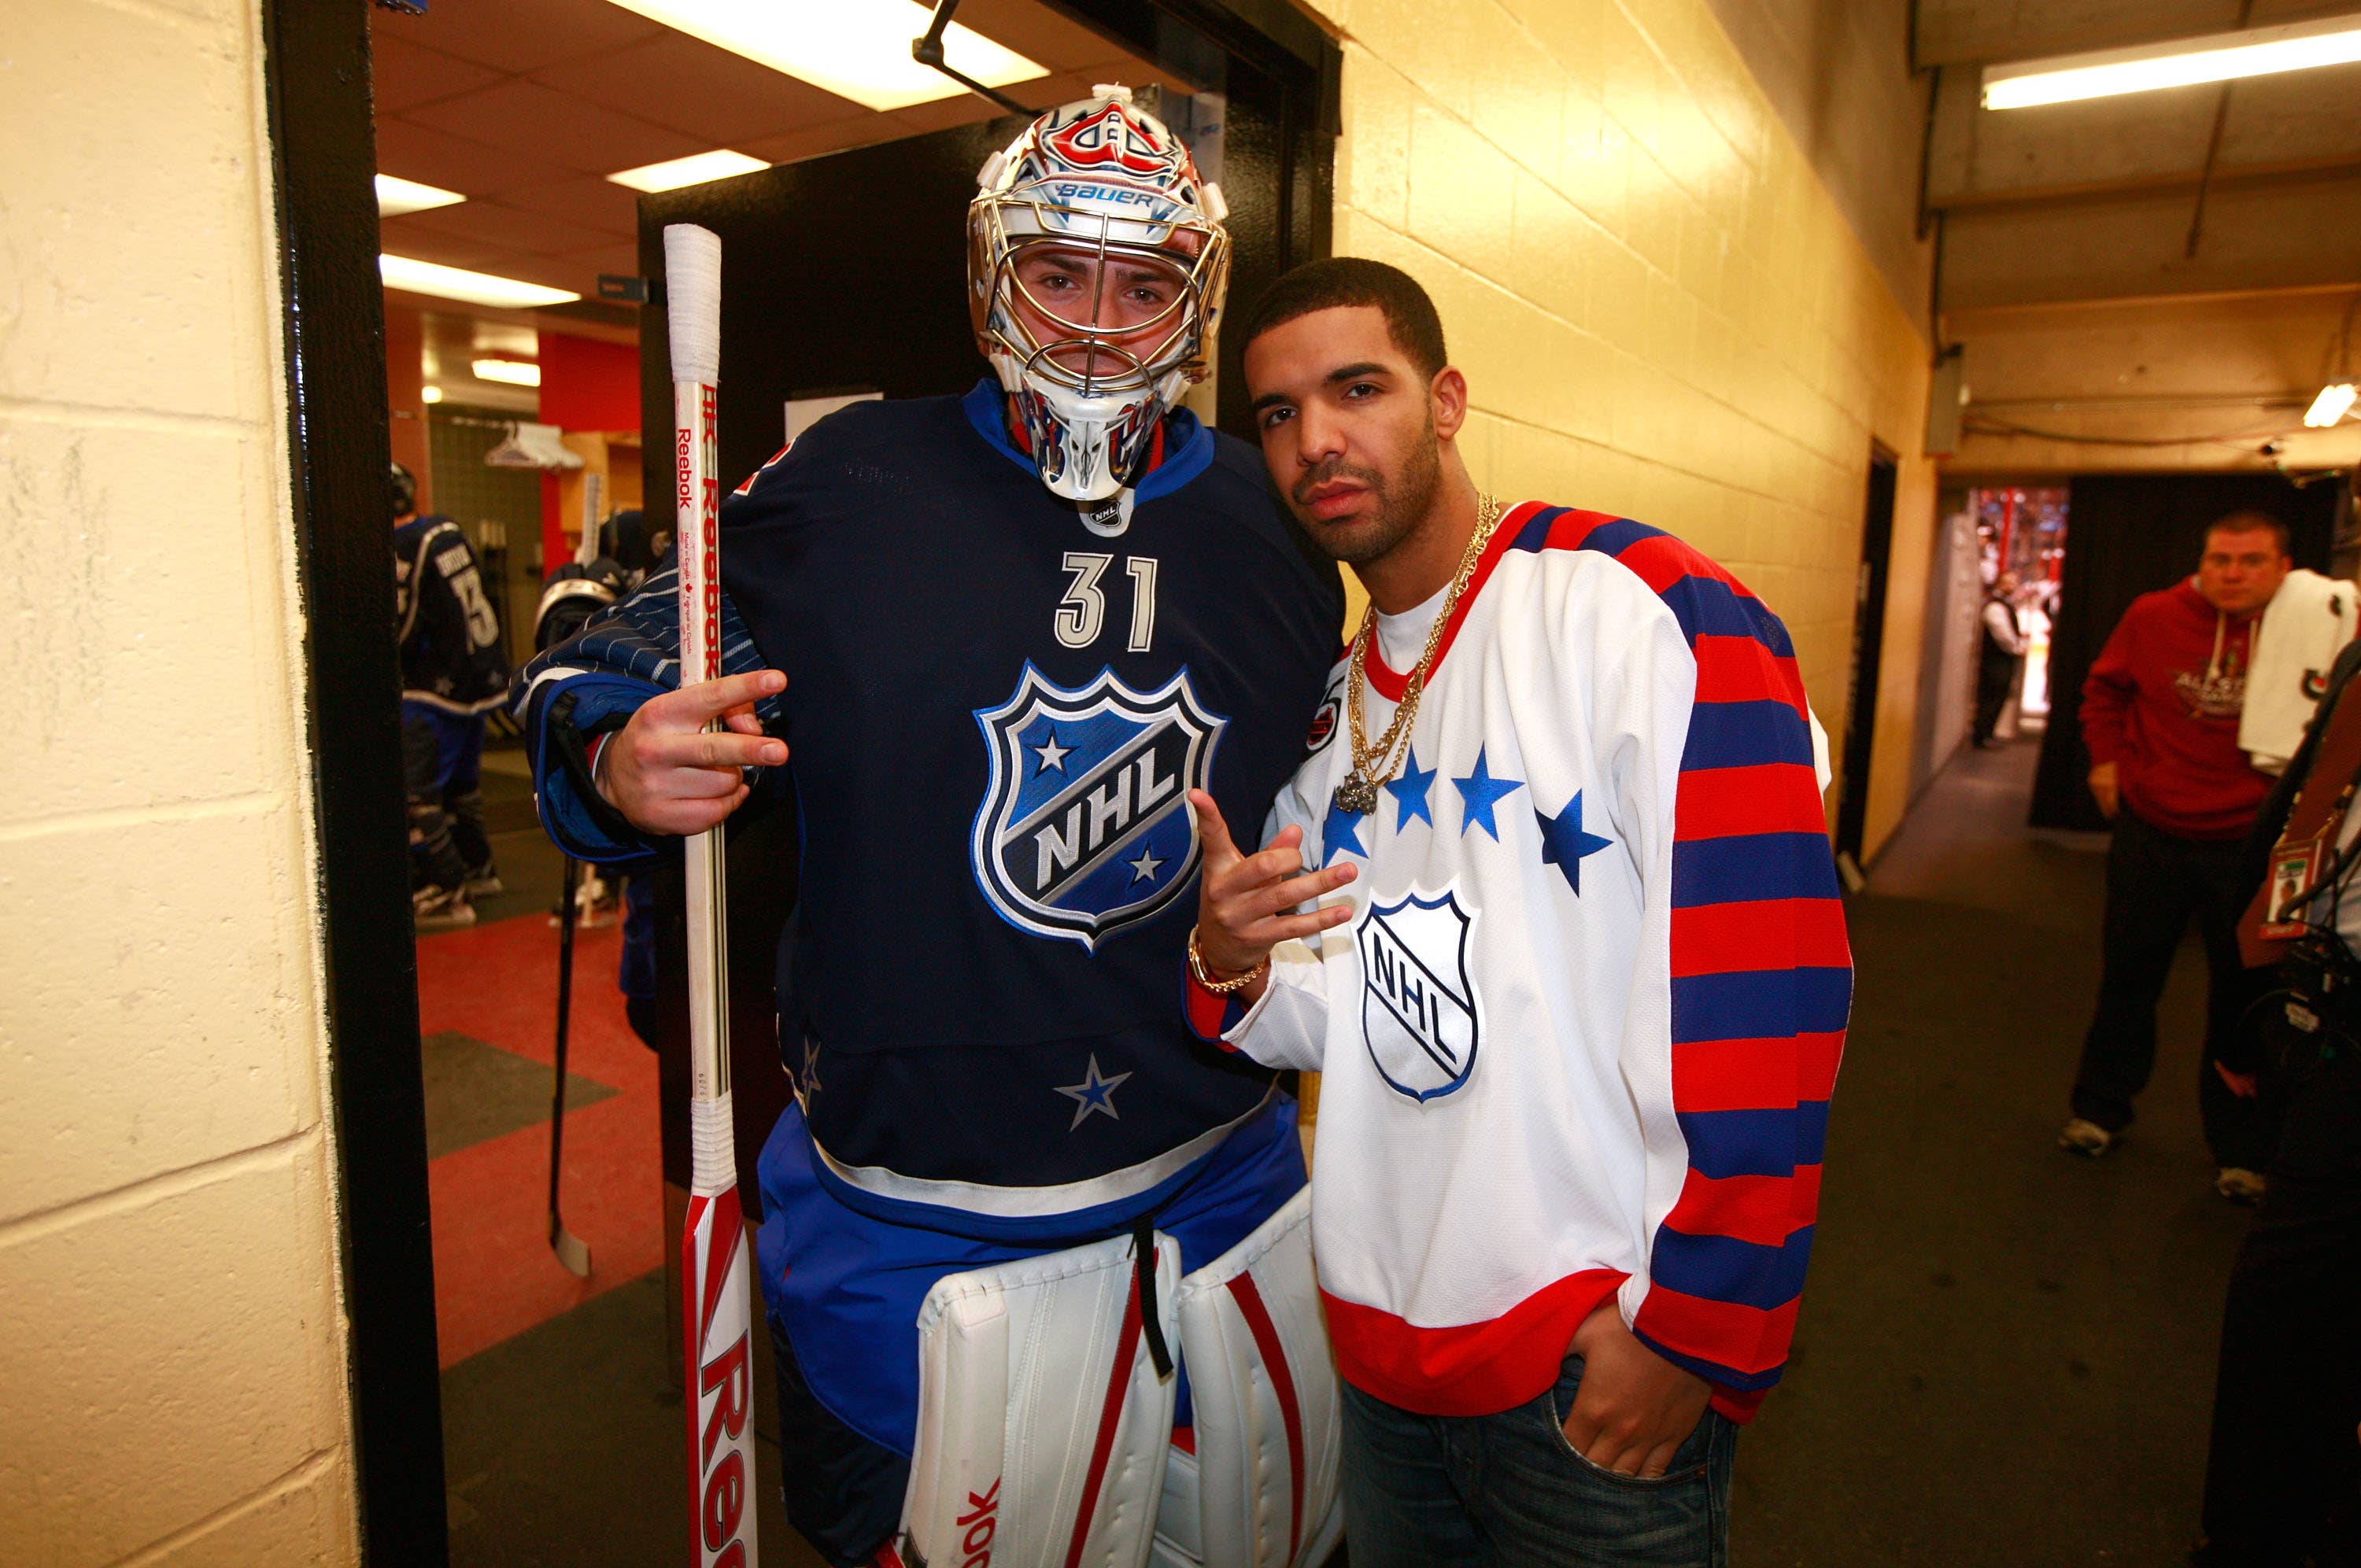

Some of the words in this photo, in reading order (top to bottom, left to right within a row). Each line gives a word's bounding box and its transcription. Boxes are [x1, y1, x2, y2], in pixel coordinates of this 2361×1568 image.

[678, 429, 692, 509] Reebok
[1096, 506, 1115, 521] NHL
[703, 478, 719, 680] Reebok
[1055, 552, 1158, 652] 31
[1033, 747, 1175, 891] NHL
[1374, 932, 1457, 1064] NHL
[701, 1328, 748, 1568] Re
